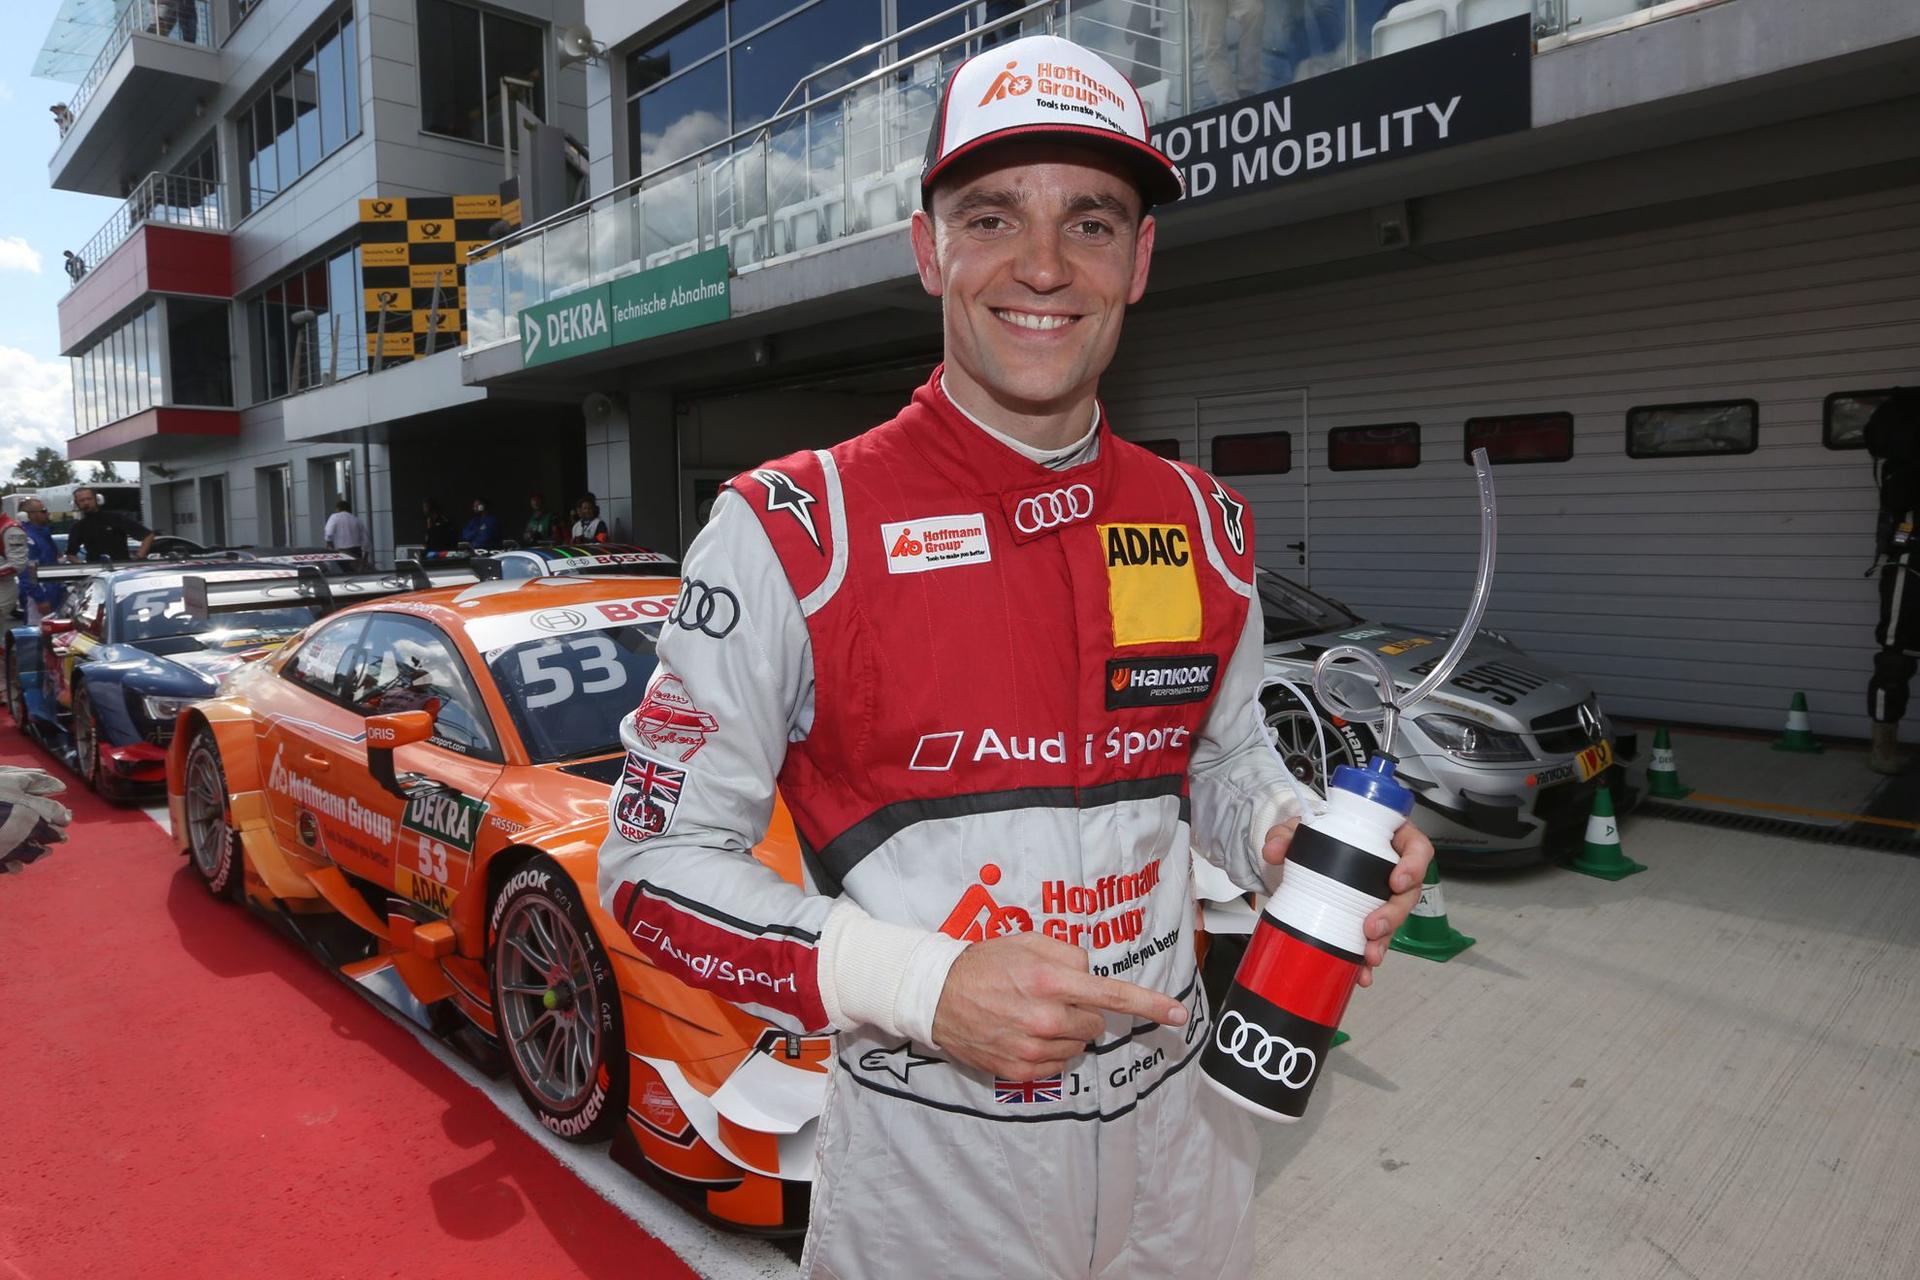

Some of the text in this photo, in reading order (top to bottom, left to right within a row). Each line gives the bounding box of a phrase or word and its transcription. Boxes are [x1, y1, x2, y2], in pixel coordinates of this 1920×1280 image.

[1037, 62, 1126, 112] Hoffmann
[1037, 78, 1099, 106] Group
[1060, 102, 1070, 111] to
[1071, 105, 1094, 116] make
[1232, 95, 1462, 188] MOBILITY
[546, 278, 726, 348] DEKRA Technische Abnahme
[923, 527, 982, 542] Hoffmann
[925, 540, 961, 554] Group
[1108, 527, 1190, 567] ADAC
[594, 553, 662, 564] BOSCH
[517, 636, 628, 709] 53
[428, 735, 467, 753] orsport.com
[972, 725, 1190, 765] Audi Sport
[288, 770, 393, 846] Hoffmann Group
[411, 793, 471, 844] DEKRA
[418, 836, 449, 884] 53
[411, 873, 450, 917] ADAC
[660, 936, 798, 993] Audi Sport
[1093, 963, 1109, 977] to
[1069, 1073, 1090, 1096] J.
